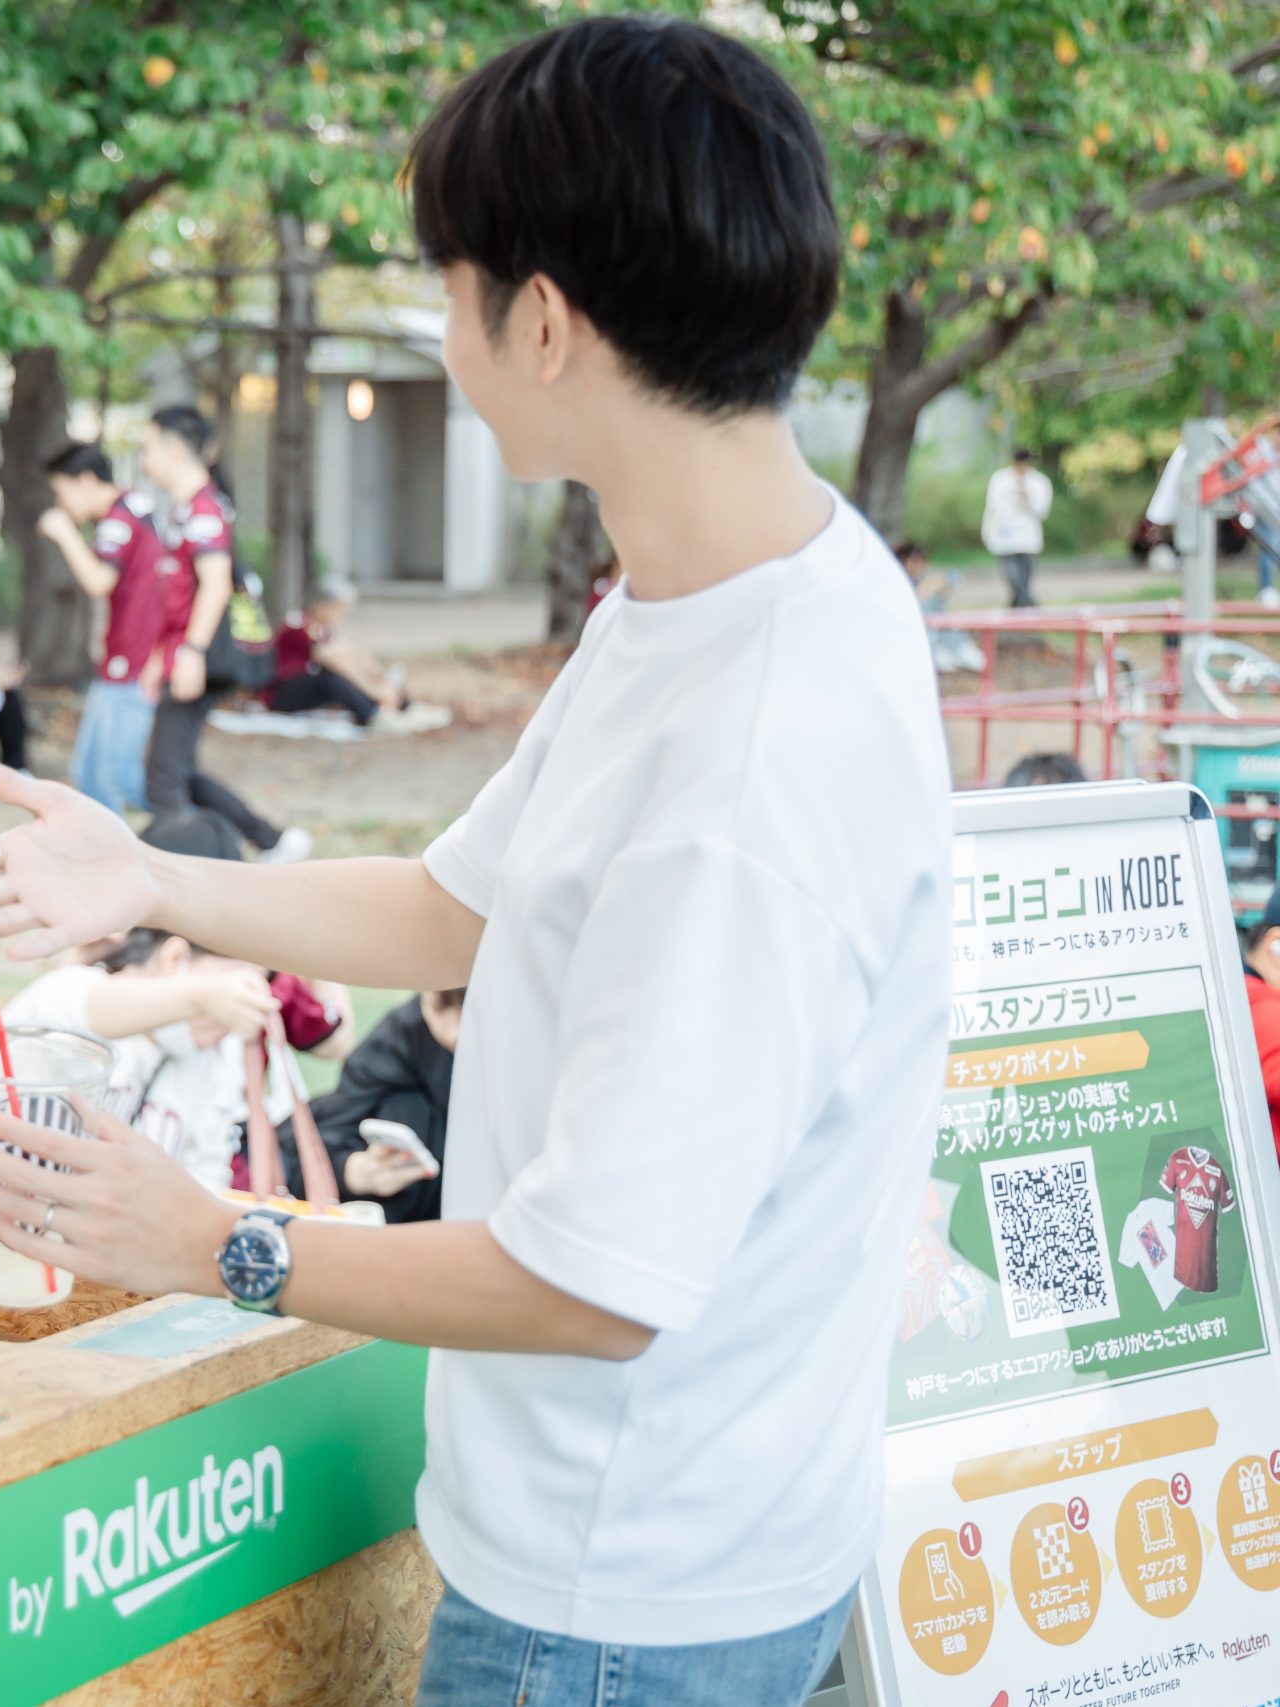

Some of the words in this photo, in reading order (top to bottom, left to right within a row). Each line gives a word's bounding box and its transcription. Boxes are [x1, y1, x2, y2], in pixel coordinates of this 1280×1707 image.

[1095, 875, 1113, 914] IN
[1120, 854, 1184, 912] KOBE
[952, 1044, 1087, 1086] チェックポイント
[1056, 1432, 1122, 1473] ステップ
[9, 1576, 53, 1637] by
[62, 1444, 284, 1609] Rakuten
[912, 1605, 988, 1640] スマホカメラを
[941, 1632, 968, 1656] 起動
[1222, 1633, 1271, 1659] Rakuten
[1106, 1690, 1138, 1707] FUTURE
[1140, 1678, 1182, 1698] TOGETHER
